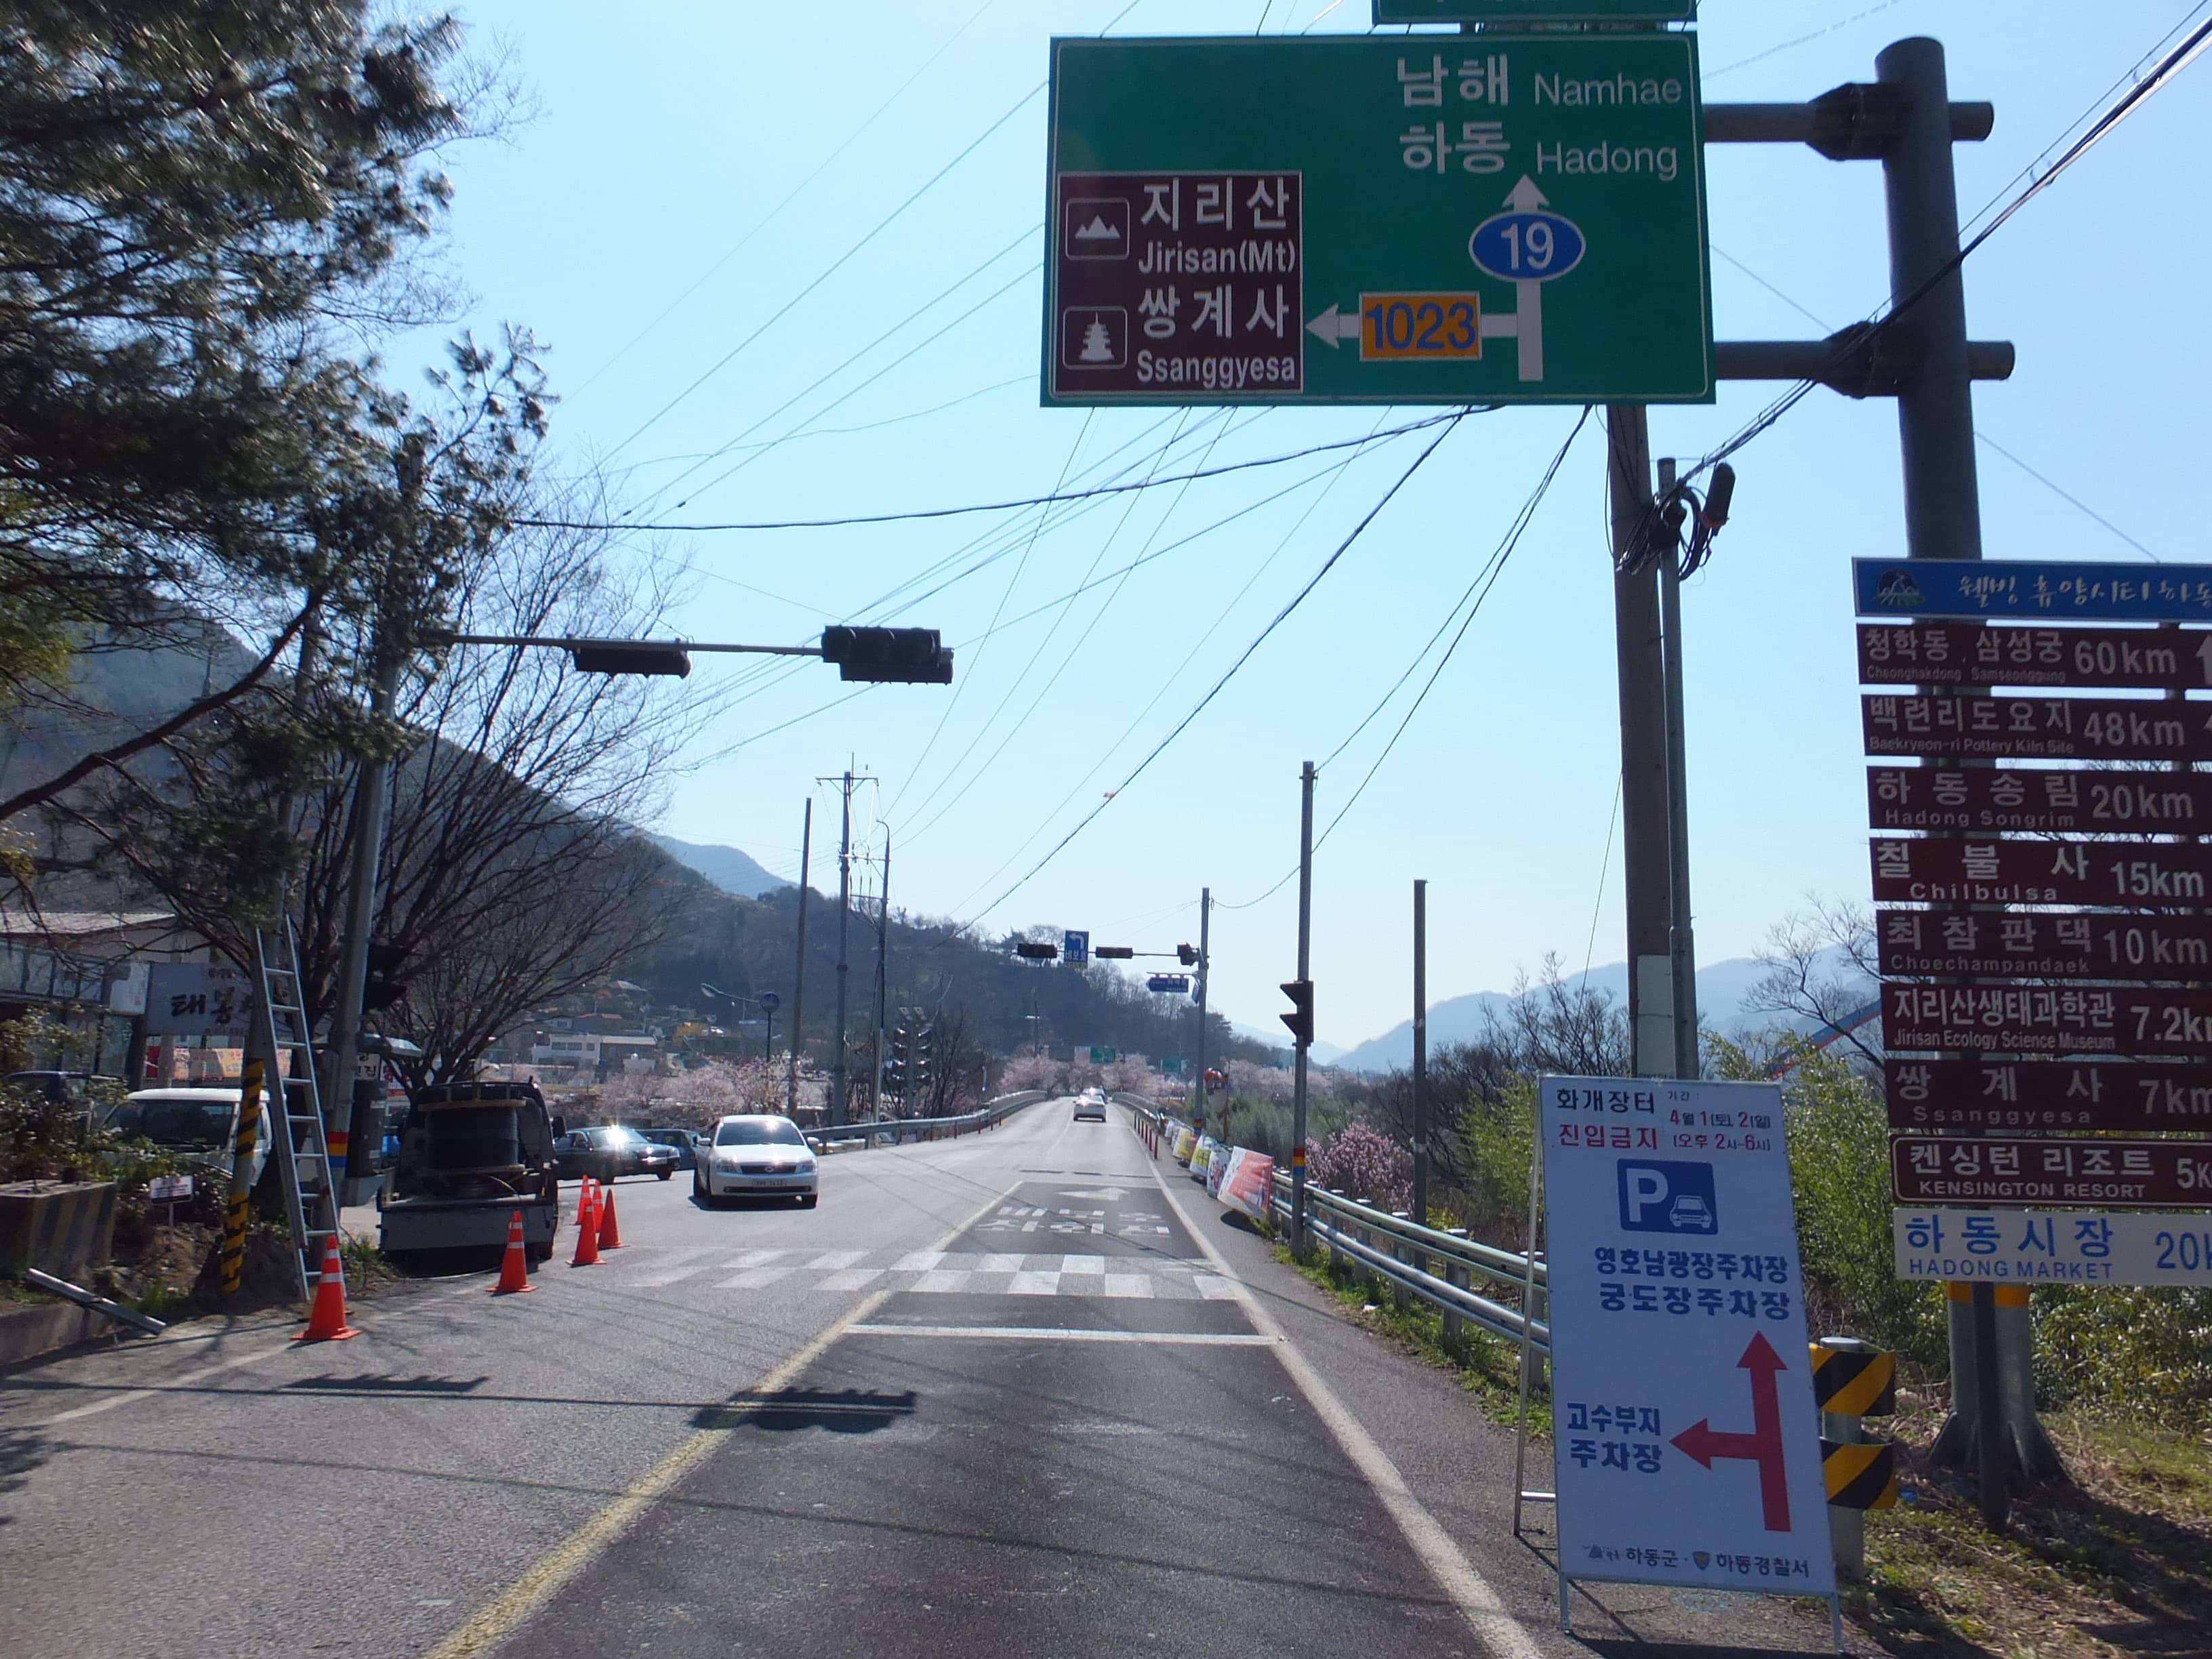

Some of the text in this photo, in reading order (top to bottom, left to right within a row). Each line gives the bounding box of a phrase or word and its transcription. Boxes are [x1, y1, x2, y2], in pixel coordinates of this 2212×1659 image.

[1397, 54, 1509, 107] 남해
[1534, 73, 1683, 106] Namhae
[1399, 121, 1511, 174] 하동
[1536, 141, 1678, 182] Hadong
[1140, 177, 1290, 231] 지리산
[1137, 240, 1296, 275] Jirisan(Mt)
[1500, 221, 1554, 270] 19
[1137, 283, 1290, 340] 쌍계사
[1364, 303, 1476, 352] 1023
[1136, 350, 1296, 390] Ssanggyesa
[1975, 629, 2063, 663] 삼성궁
[2074, 639, 2177, 676] 60km
[1963, 737, 2012, 754] Pottery
[2015, 739, 2045, 753] Kiln
[2047, 740, 2075, 754] Site
[2083, 711, 2186, 747] 48km
[1885, 808, 2075, 829] Hadong Songrim
[2089, 784, 2194, 820] 20km
[1909, 882, 2057, 901] Chilbulsa
[2109, 861, 2206, 898] 15km
[1890, 954, 2090, 975] Choechampandaek
[2103, 928, 2209, 965] 10km
[1894, 988, 2116, 1029] 지리산생태과학관
[1893, 1028, 2116, 1050] Jirisan Ecology Science Museum
[1556, 1087, 1656, 1114] 화개장터
[1913, 1105, 2091, 1125] Ssanggyesa
[1559, 1123, 1658, 1150] 진입금지
[1909, 1144, 2021, 1176] 켄싱턴
[2043, 1147, 2155, 1177] 리조트
[1626, 1168, 1668, 1223] P
[1919, 1180, 2146, 1199] KENSINGTON RESORT
[1904, 1213, 2114, 1258] 하동시장
[1594, 1246, 1788, 1284] 영호남광장주차장
[1909, 1258, 2113, 1279] HADONG MARKET
[1599, 1282, 1790, 1321] 궁도장주차장
[1566, 1401, 1662, 1437] 고수부지
[1570, 1438, 1662, 1474] 주차장
[1625, 1547, 1679, 1568] 하동군
[1715, 1553, 1810, 1578] 하동경찰서
